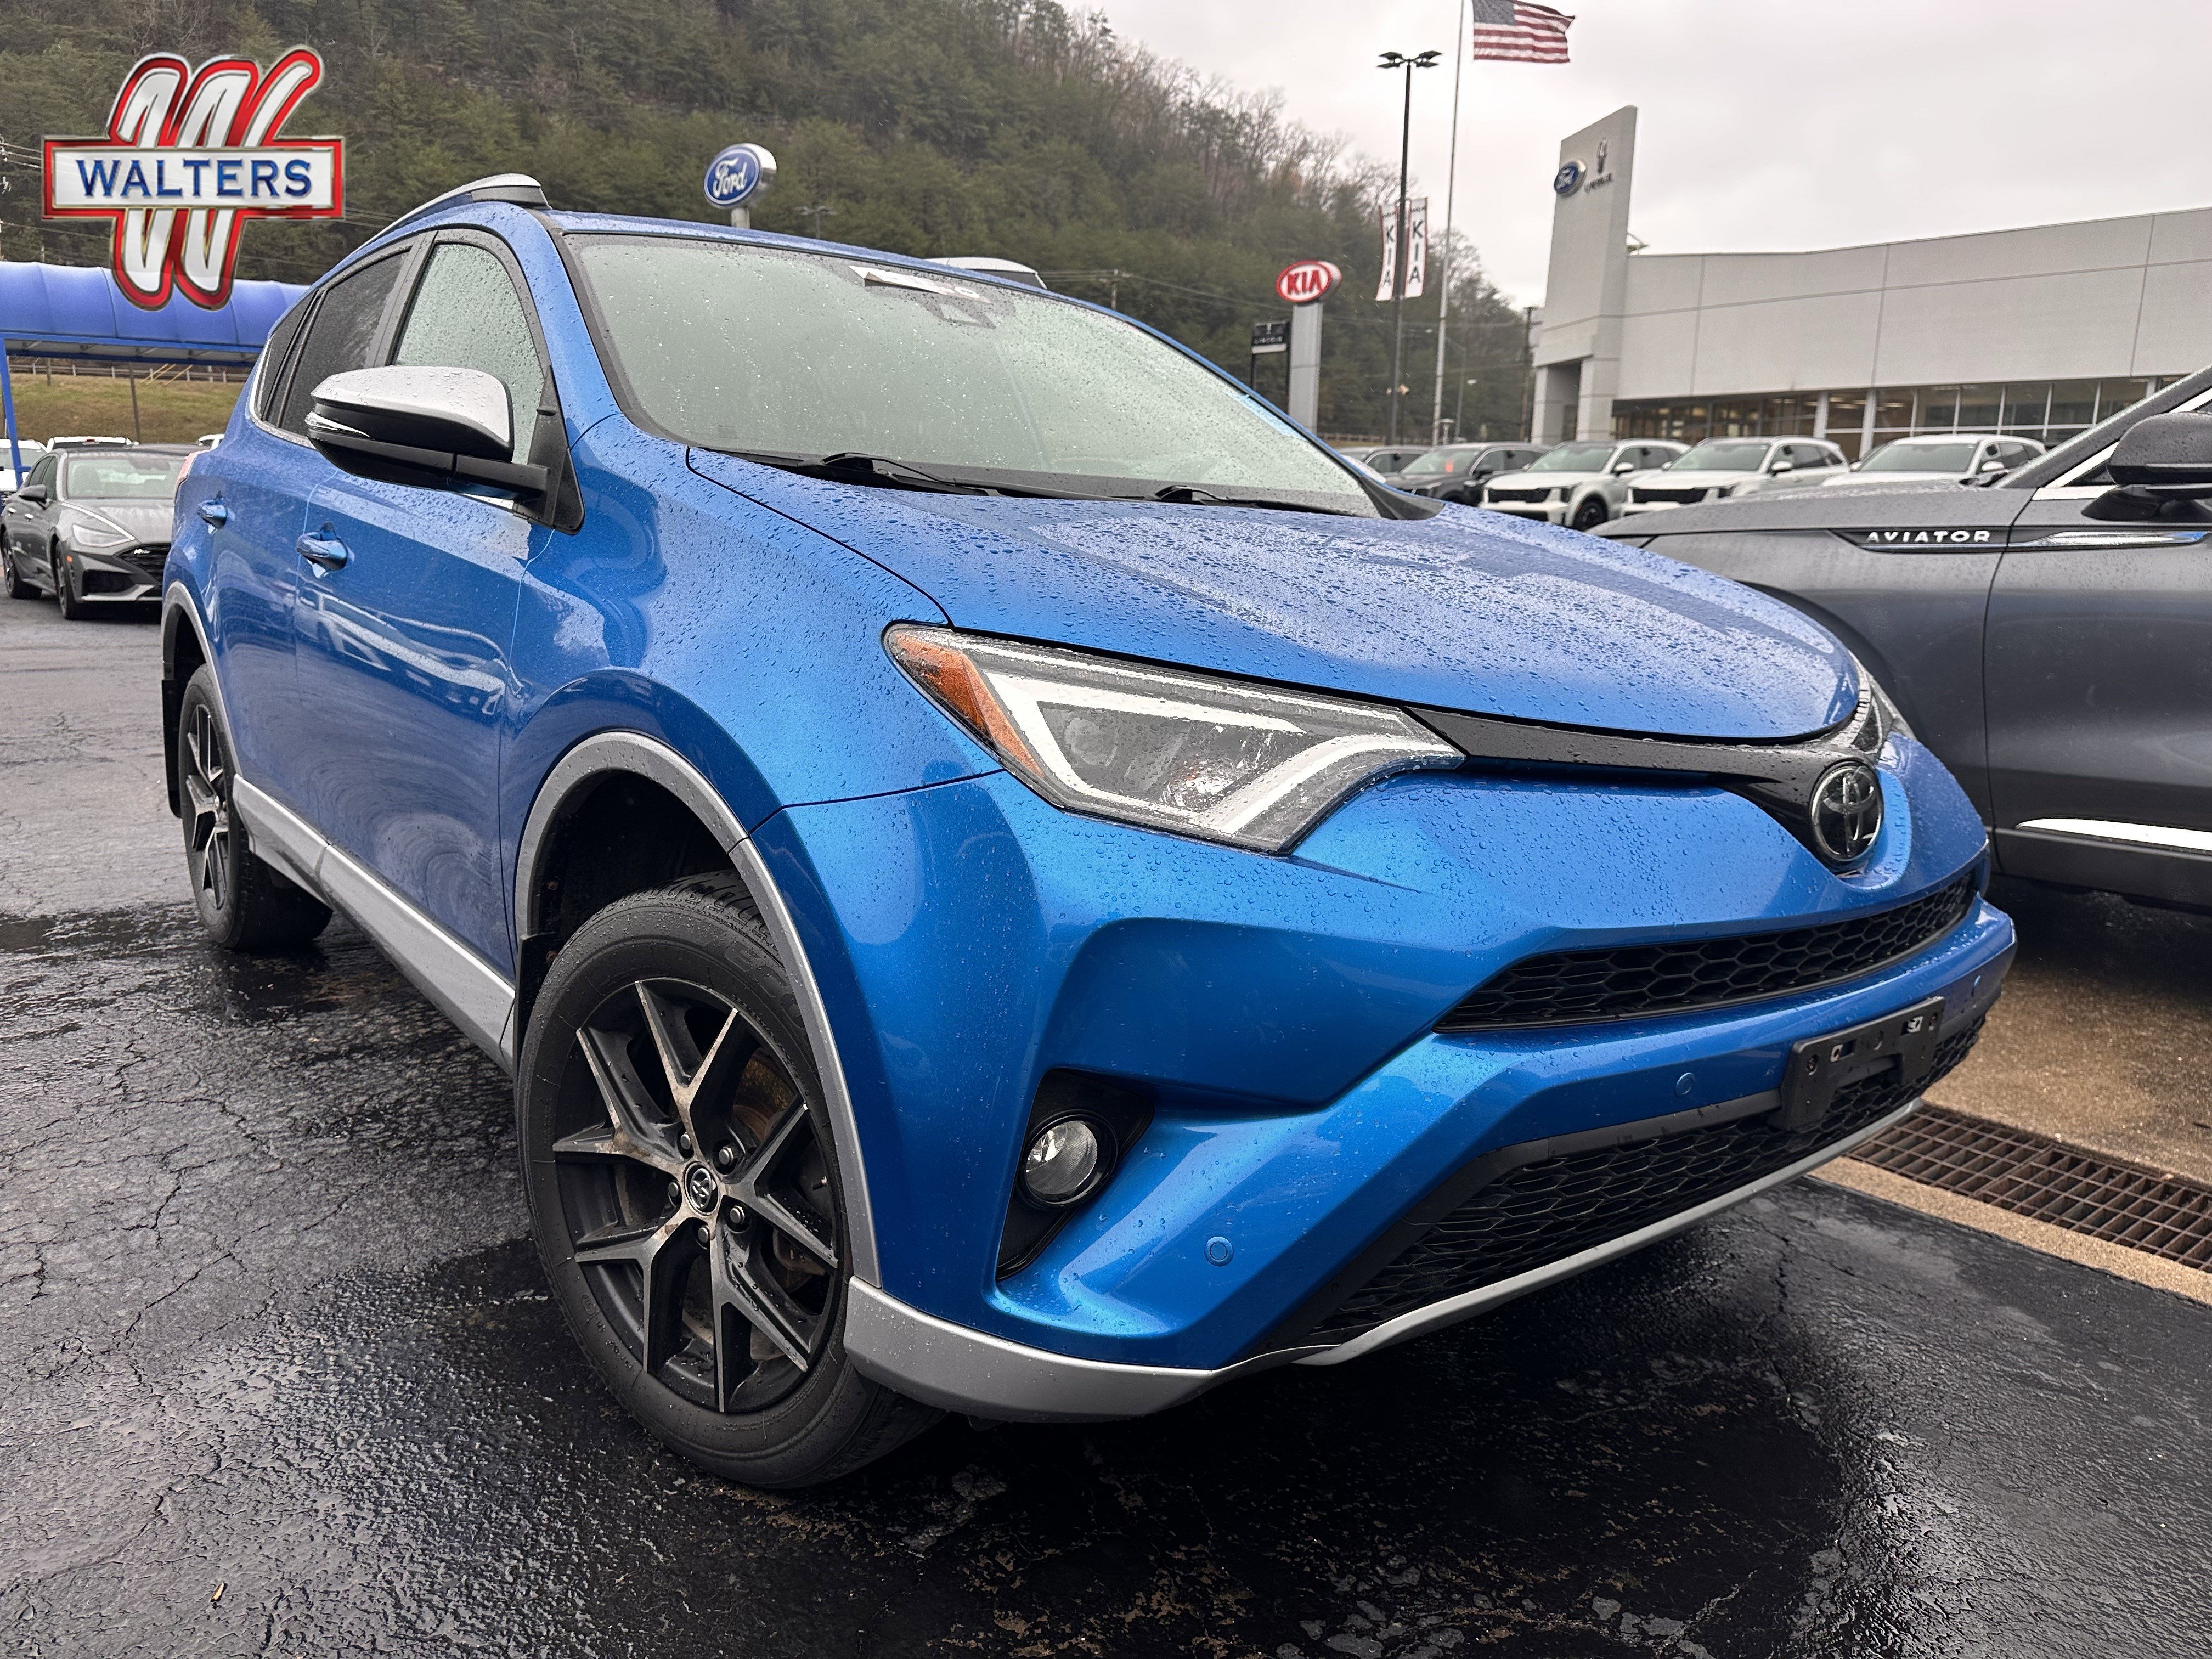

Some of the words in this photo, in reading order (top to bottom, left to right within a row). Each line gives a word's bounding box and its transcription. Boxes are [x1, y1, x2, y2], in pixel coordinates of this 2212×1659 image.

[713, 157, 748, 198] Ford
[1381, 224, 1394, 288] KIA
[1409, 220, 1424, 284] KIA
[1286, 270, 1322, 295] KIA
[1866, 530, 1990, 543] AVIATOR
